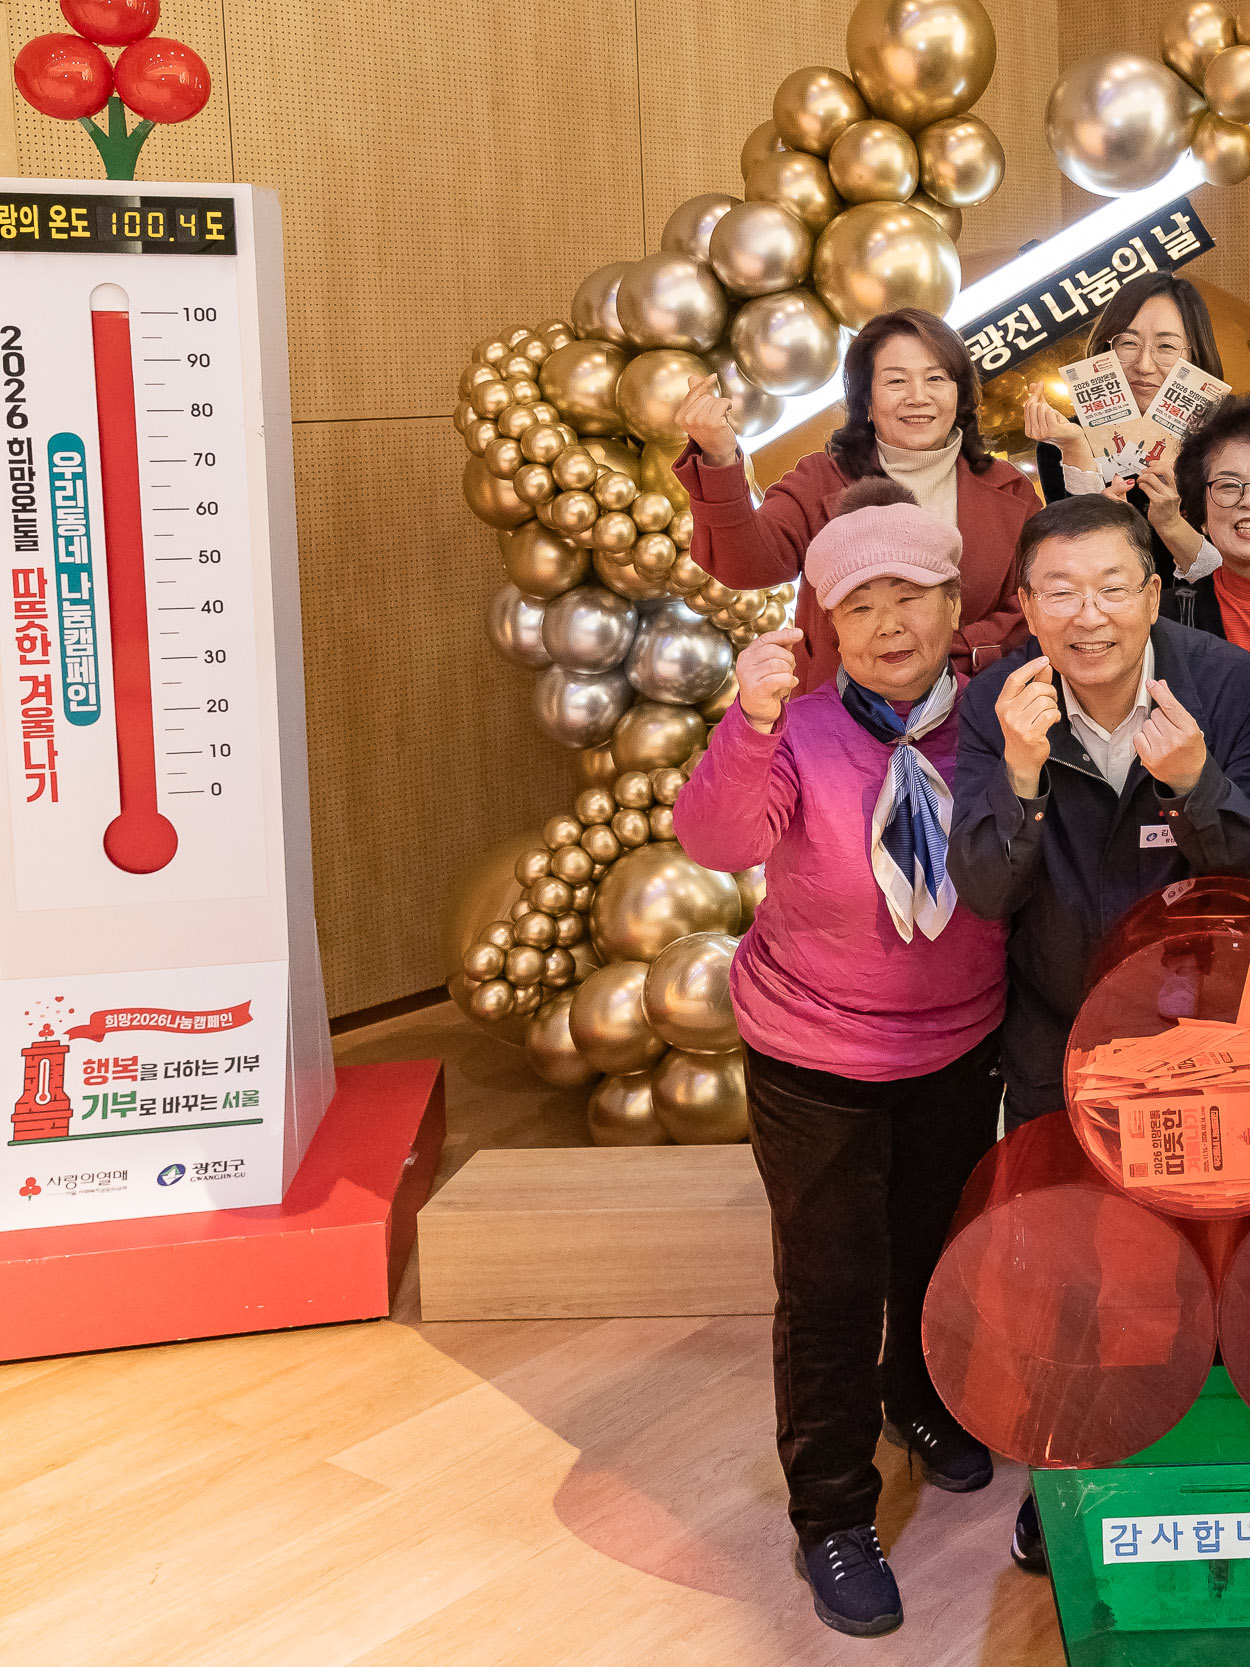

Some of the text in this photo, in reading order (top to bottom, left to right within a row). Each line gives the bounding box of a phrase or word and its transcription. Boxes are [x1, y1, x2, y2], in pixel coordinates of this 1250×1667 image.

[48, 205, 91, 239] 온도
[205, 211, 225, 240] 도
[963, 211, 1201, 371] 광진 나눔의 날
[183, 307, 217, 322] 100
[187, 353, 211, 368] 90
[1076, 380, 1122, 404] 따뜻한
[191, 403, 213, 417] 80
[1081, 393, 1126, 414] 겨울나기
[193, 453, 216, 467] 70
[196, 502, 218, 516] 60
[0, 325, 59, 803] 2026 희망온돌 따뜻한 겨울나기
[198, 550, 221, 564] 50
[52, 451, 98, 712] 우리동네 나눔캠페인
[201, 600, 224, 614] 40
[204, 650, 227, 664] 30
[206, 699, 229, 713] 20
[209, 743, 231, 757] 10
[210, 783, 222, 796] 0
[104, 1012, 233, 1029] 희망2026나눔캠페인
[82, 1054, 260, 1086] 행복을 더하는 기부
[81, 1089, 260, 1120] 기부로 바꾸는 서울
[1162, 1108, 1184, 1175] 따뜻한
[1183, 1109, 1200, 1173] 겨울나기
[191, 1159, 245, 1174] 광진구
[1153, 1151, 1163, 1175] 2026
[46, 1169, 129, 1190] 사랑의열매
